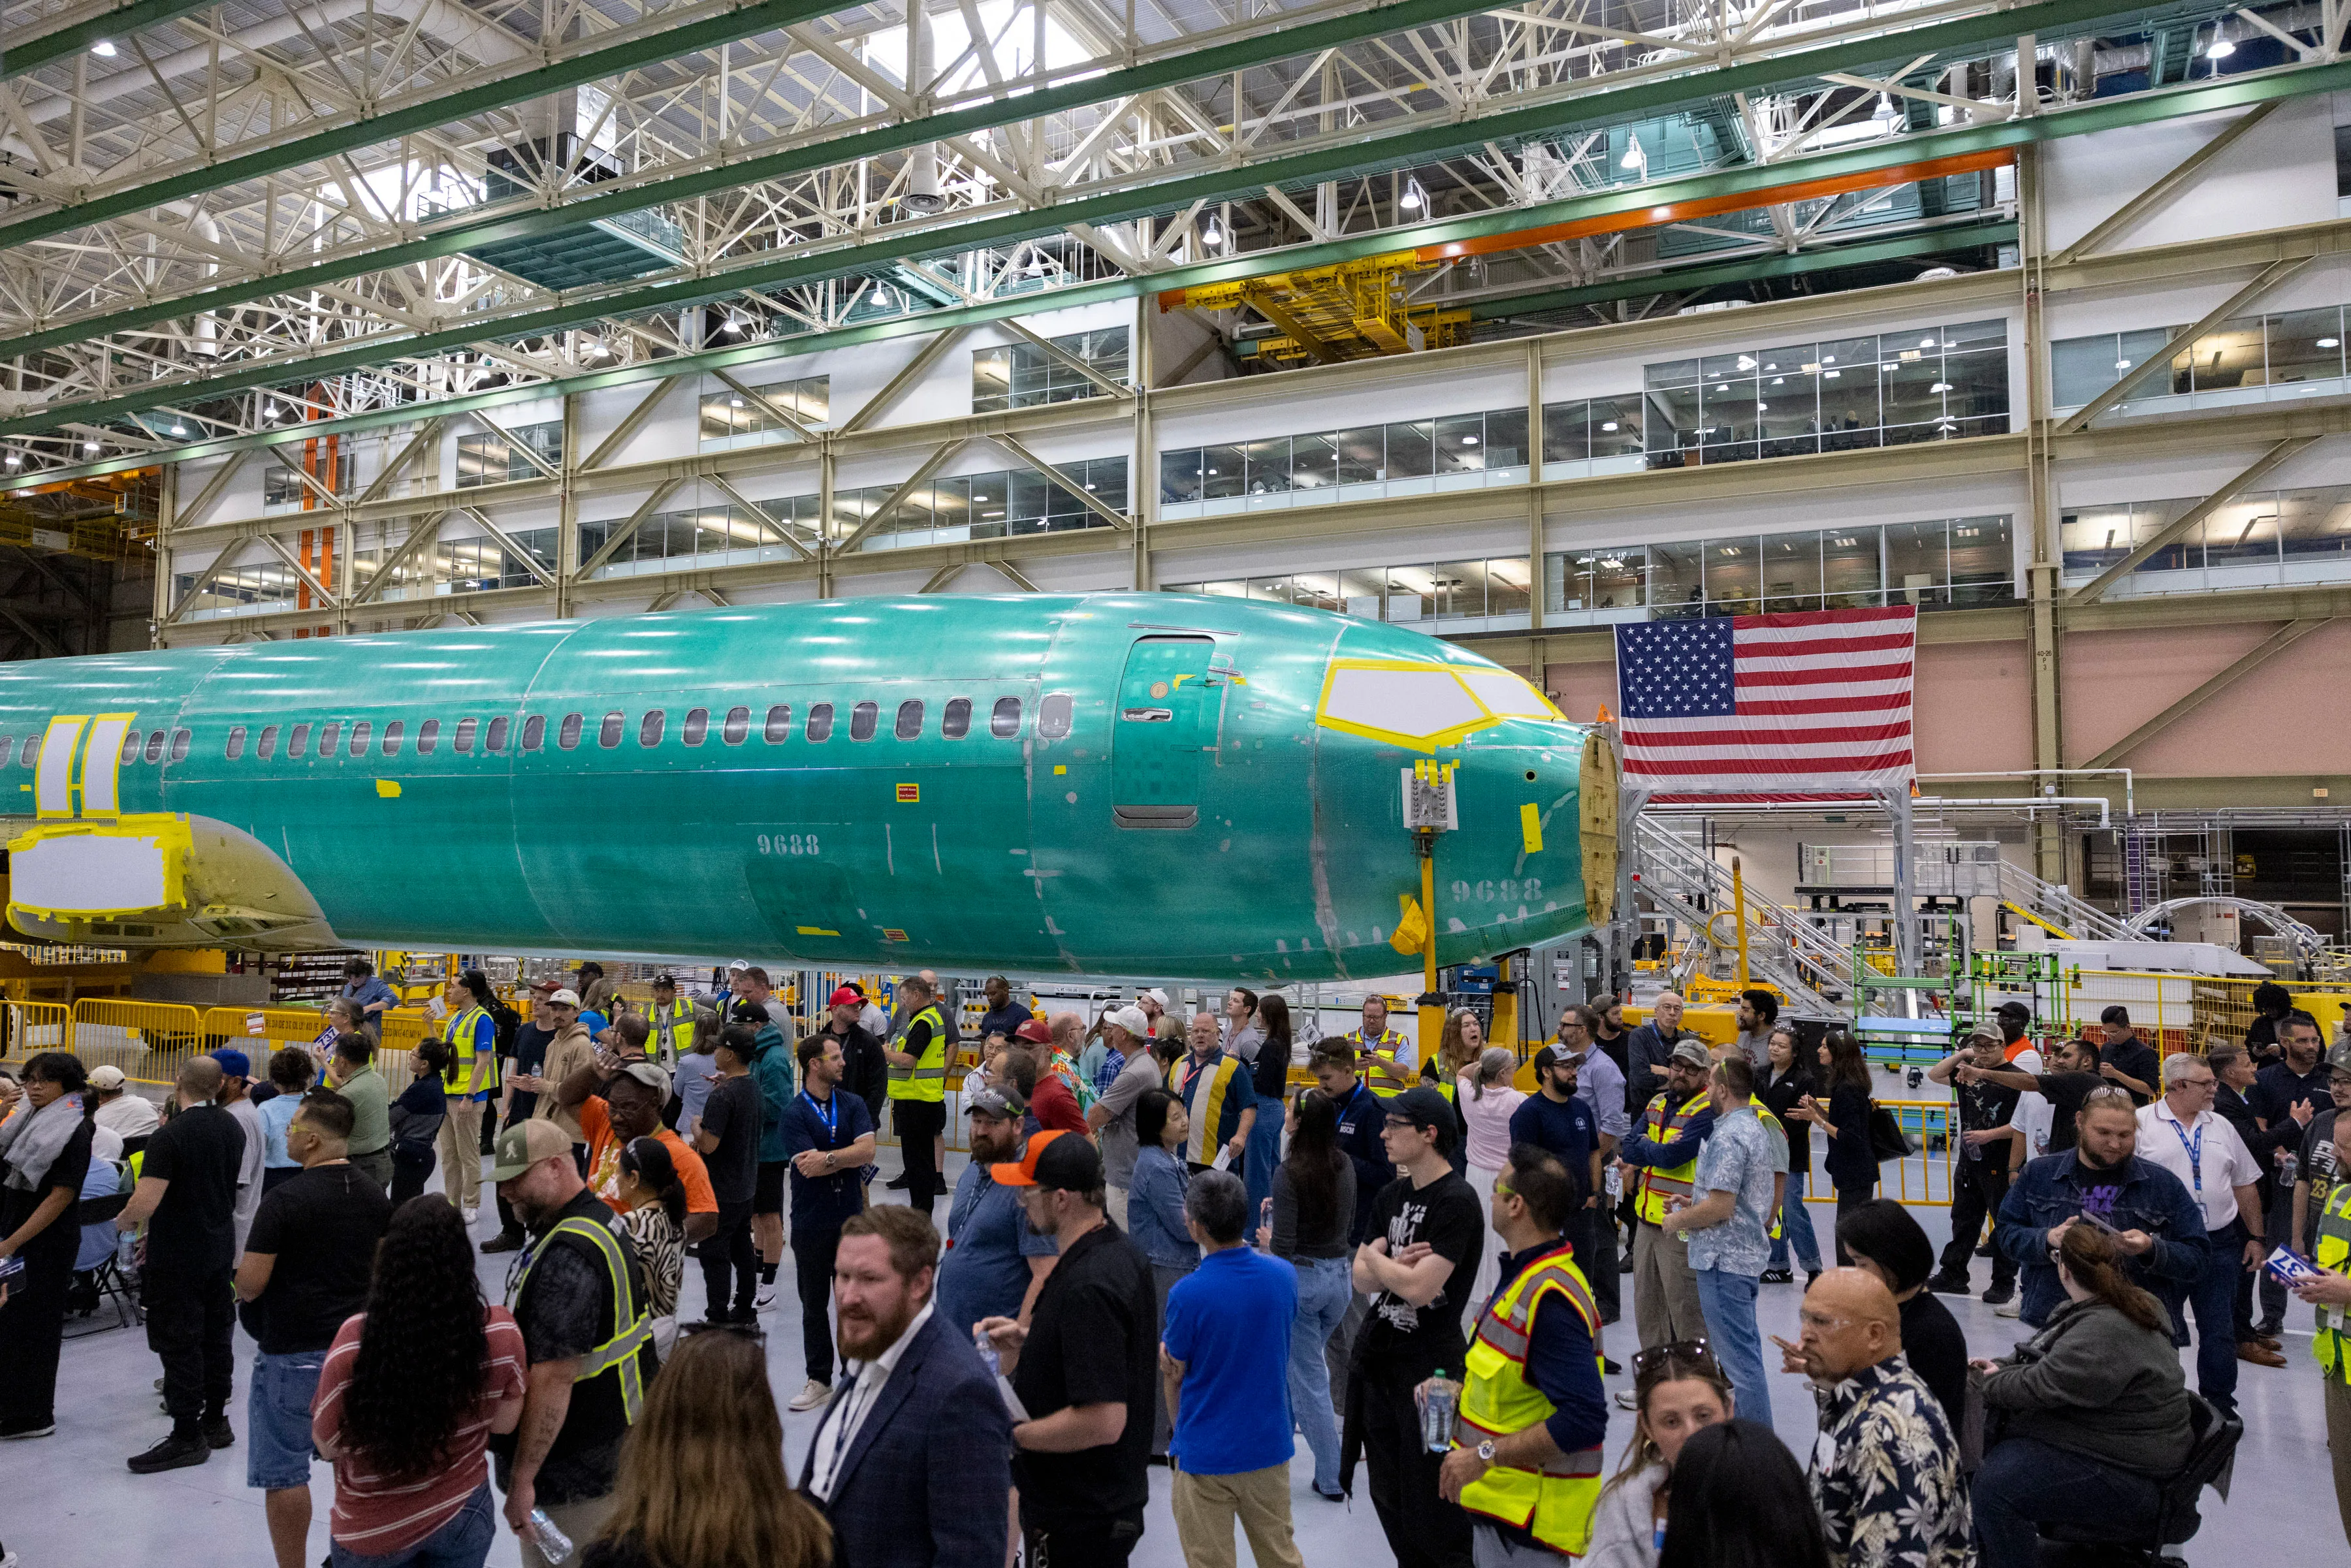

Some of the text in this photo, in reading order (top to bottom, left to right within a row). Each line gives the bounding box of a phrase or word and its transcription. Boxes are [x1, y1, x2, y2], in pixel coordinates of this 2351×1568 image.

[758, 834, 820, 855] 9688
[1452, 878, 1542, 902] 9688
[318, 1029, 336, 1046] 737
[2311, 1179, 2327, 1198] 23
